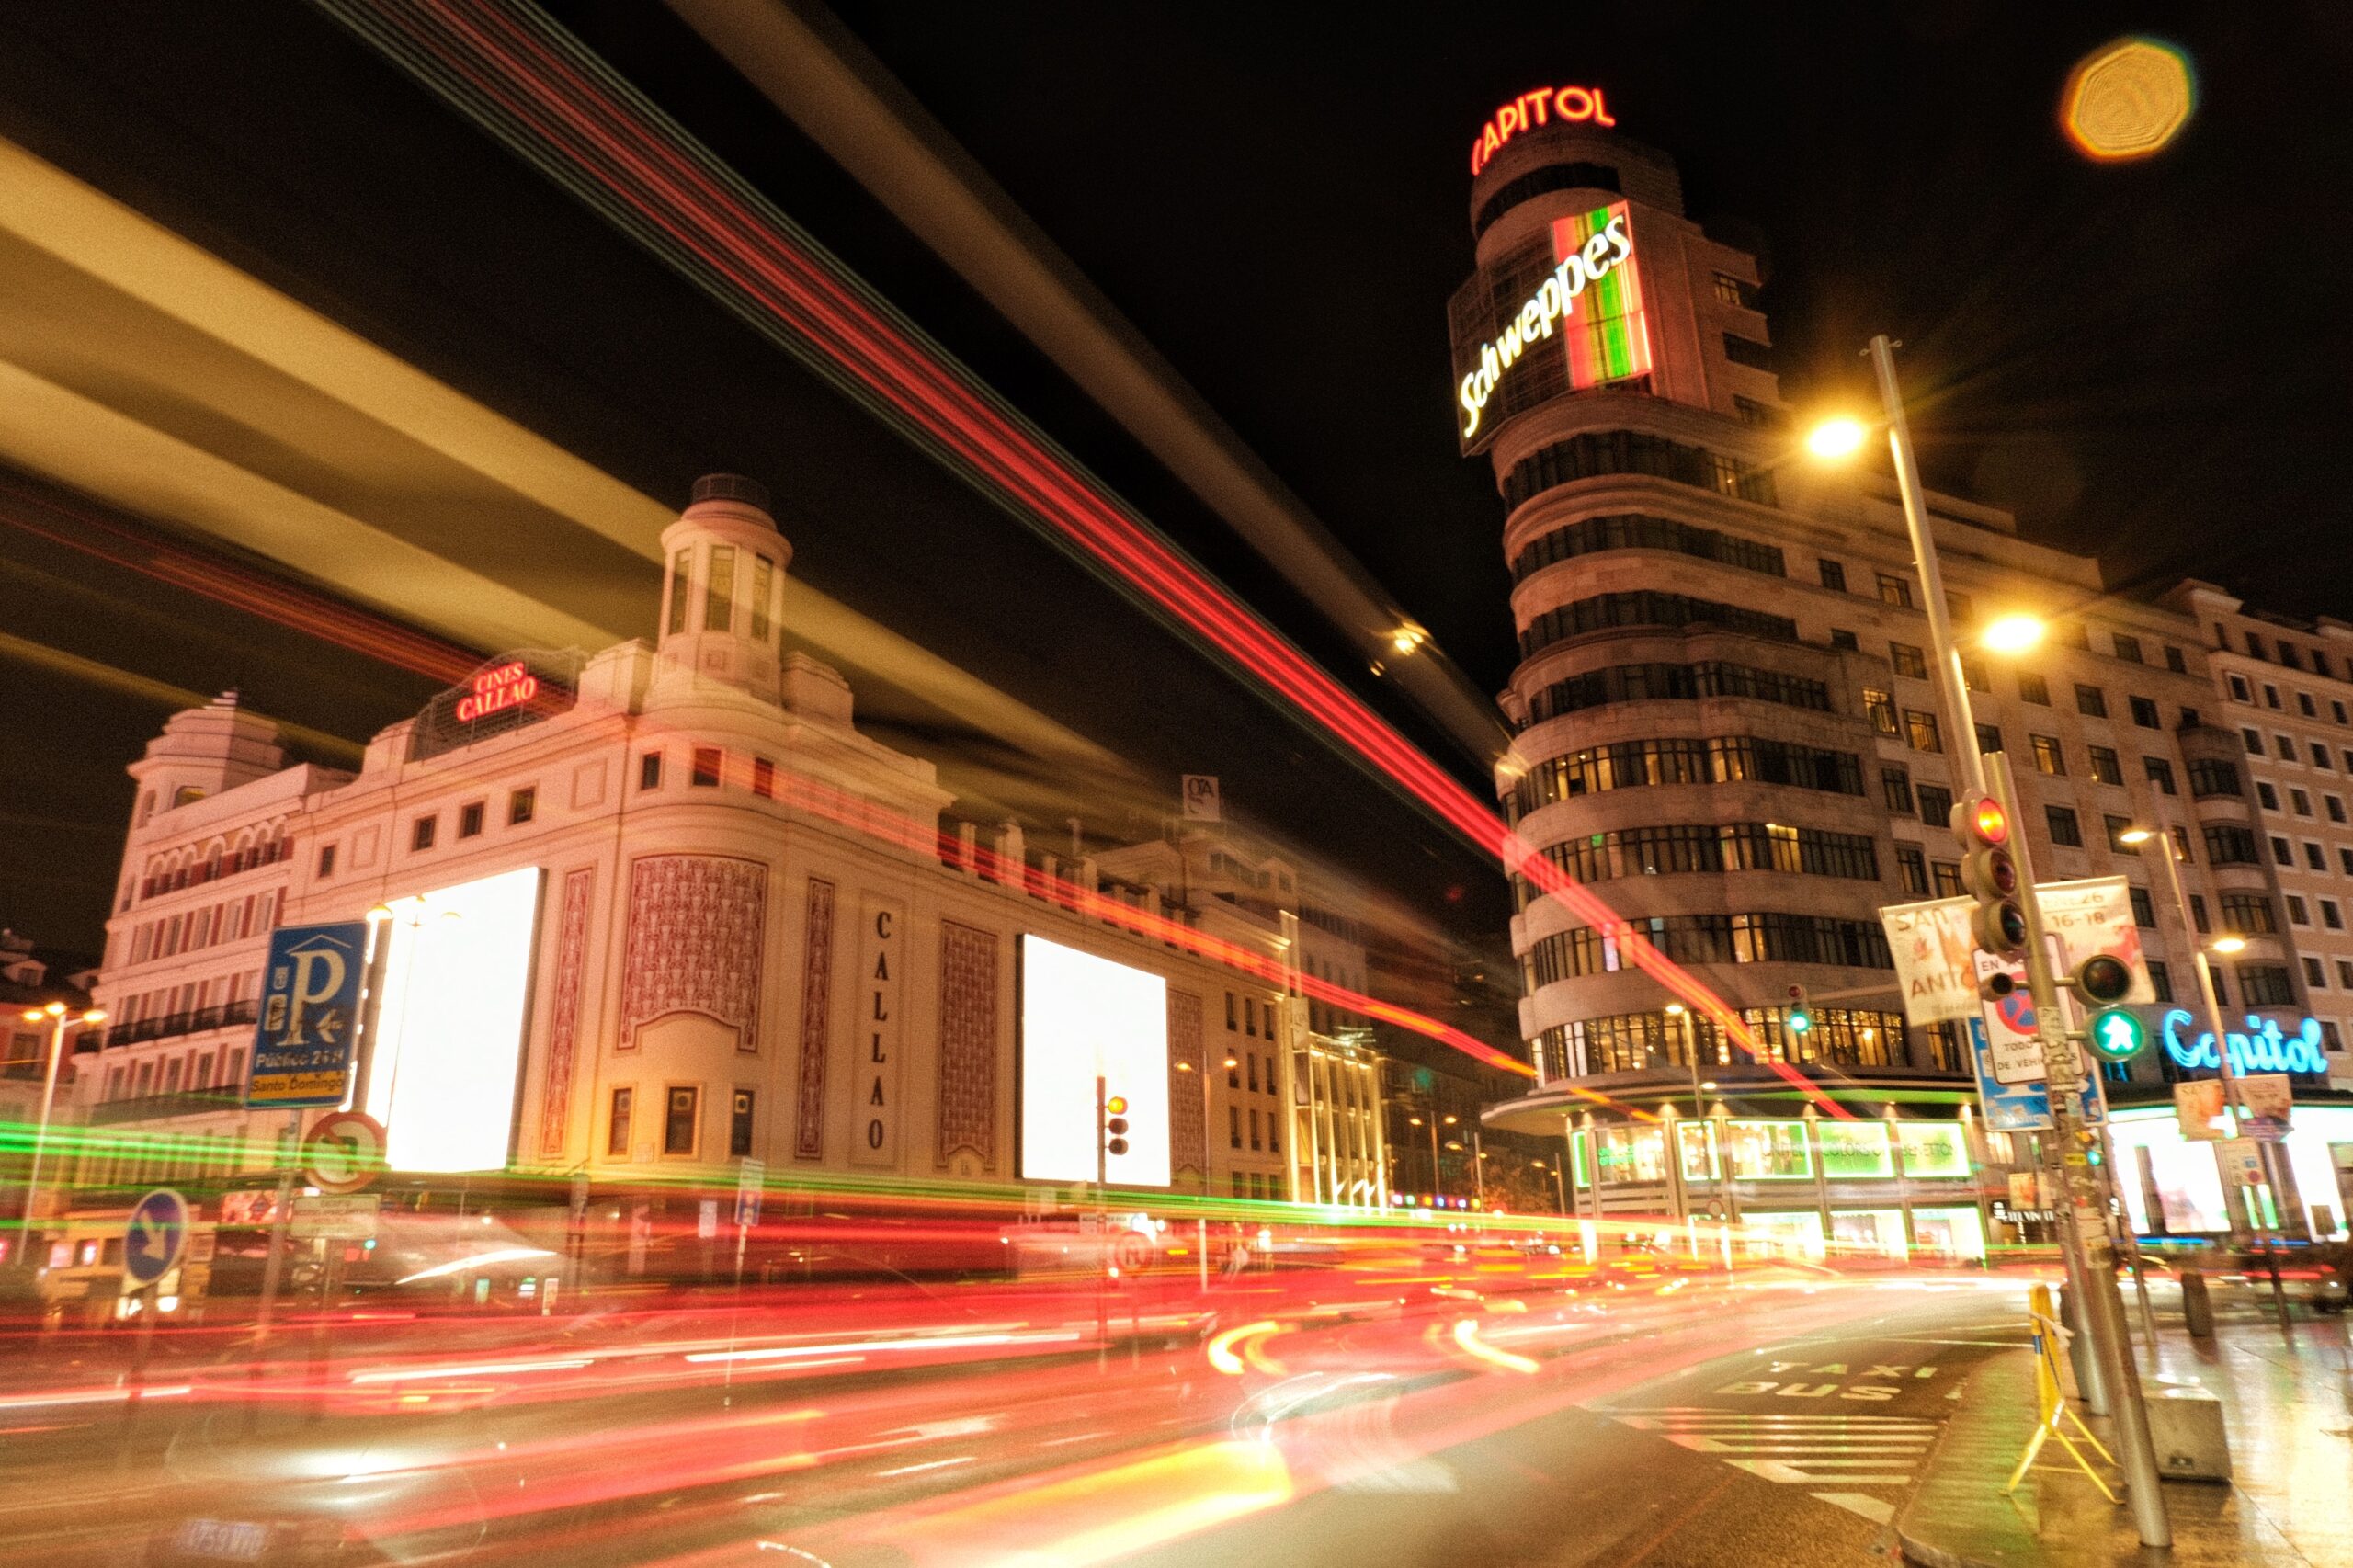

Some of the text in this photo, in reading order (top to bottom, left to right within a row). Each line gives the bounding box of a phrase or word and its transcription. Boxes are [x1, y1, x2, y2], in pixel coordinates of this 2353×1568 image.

[1470, 85, 1616, 176] CAPITOL
[1460, 213, 1631, 438] Schweppes
[474, 662, 524, 693] CINES
[457, 676, 538, 722] CALLAO
[2052, 911, 2106, 928] 16-18
[1981, 960, 1999, 971] EN
[276, 949, 346, 1046] P
[868, 911, 892, 1149] CALLAO
[2164, 1009, 2328, 1078] Capitol
[1997, 1060, 2010, 1070] DE
[1768, 1361, 1938, 1378] TAXI
[1713, 1381, 1902, 1401] BUS
